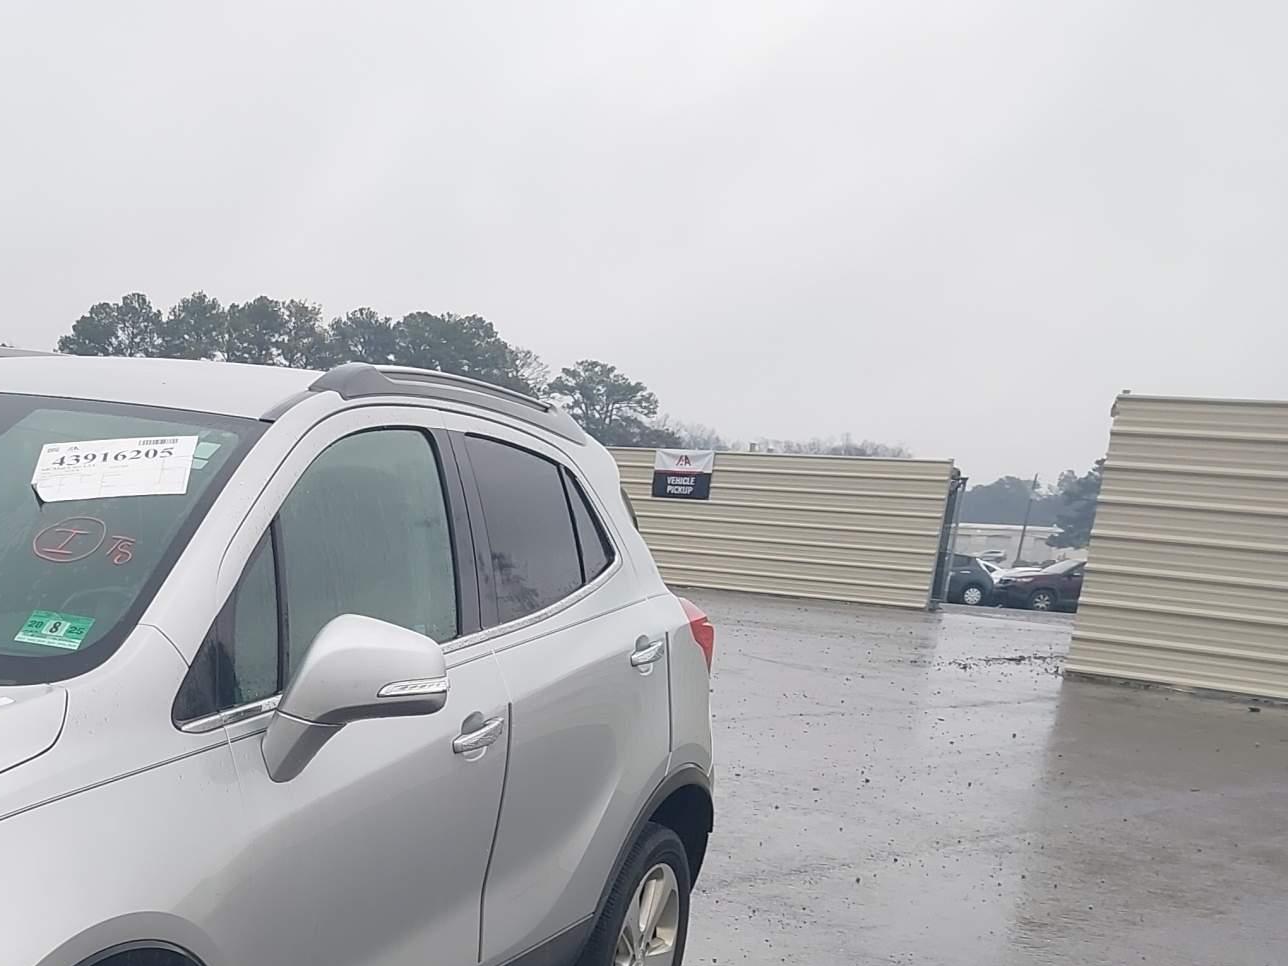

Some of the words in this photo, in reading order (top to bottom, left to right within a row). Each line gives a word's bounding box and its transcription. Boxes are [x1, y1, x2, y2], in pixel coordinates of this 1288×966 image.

[52, 447, 175, 466] 43916205
[666, 476, 696, 486] VEHICLE
[666, 485, 694, 494] PICKUP
[27, 620, 44, 629] 20
[49, 621, 62, 634] 8
